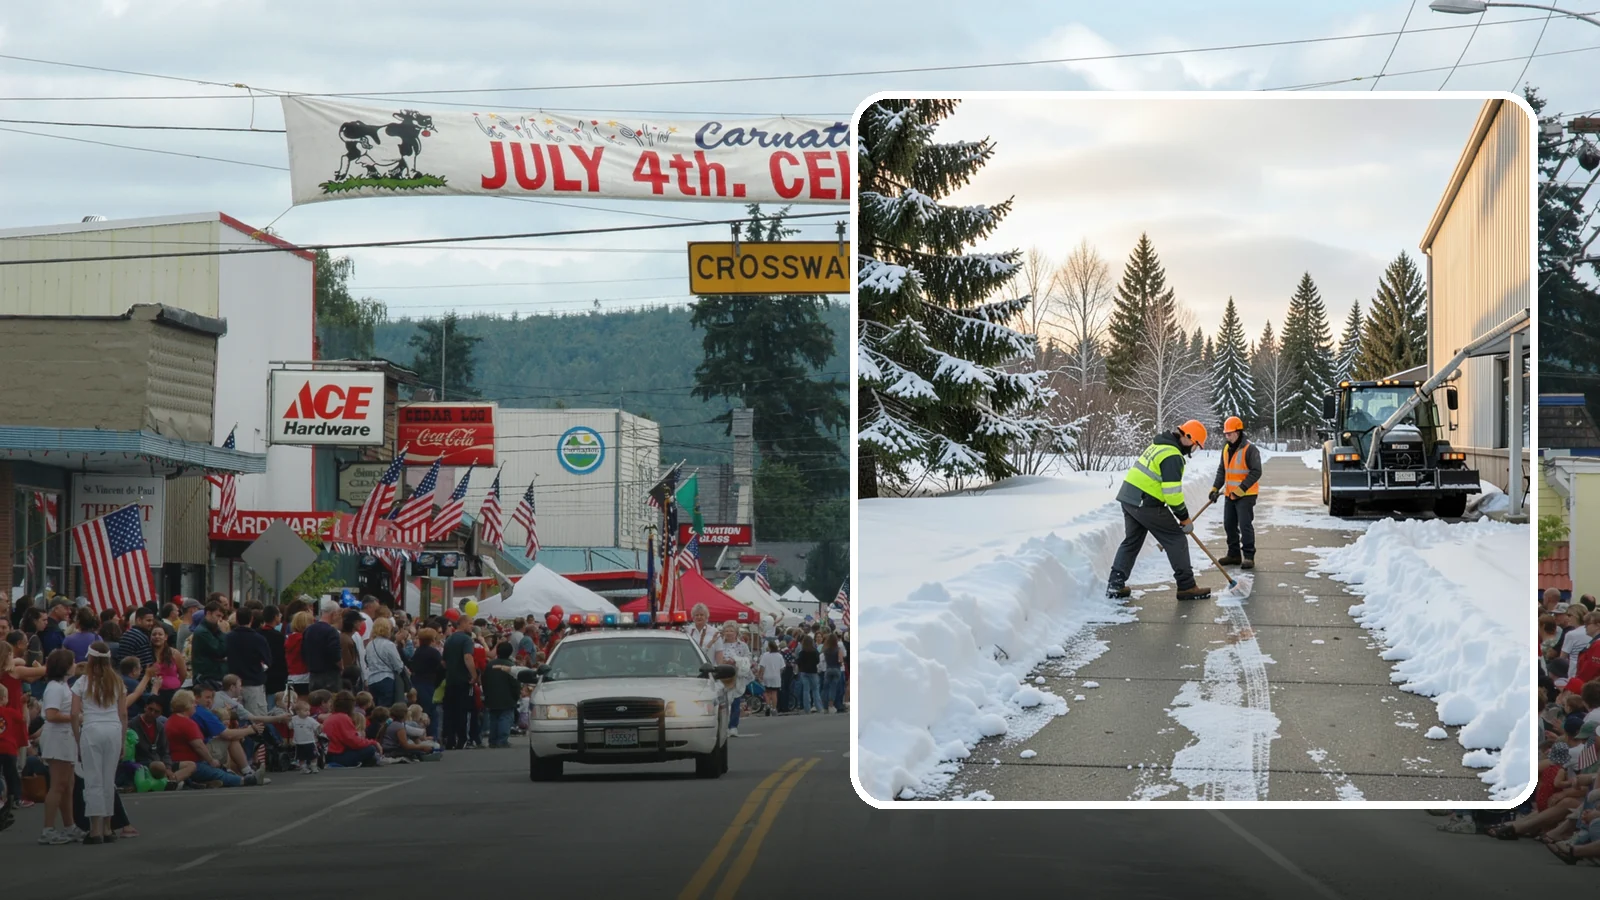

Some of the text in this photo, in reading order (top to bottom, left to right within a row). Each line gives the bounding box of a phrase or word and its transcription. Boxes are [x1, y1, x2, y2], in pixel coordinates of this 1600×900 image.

[695, 121, 850, 150] Carnat
[481, 140, 604, 192] JULY
[633, 149, 746, 197] 4th.
[697, 254, 850, 280] CROSSWA
[283, 380, 373, 420] ACE
[406, 409, 452, 421] CEDAR
[283, 421, 371, 436] Hardware
[95, 484, 124, 495] Vincent
[126, 486, 135, 495] de
[137, 485, 155, 495] Paul
[212, 515, 330, 535] HARDARE
[688, 526, 741, 535] CRNATION
[699, 535, 730, 543] GLASS
